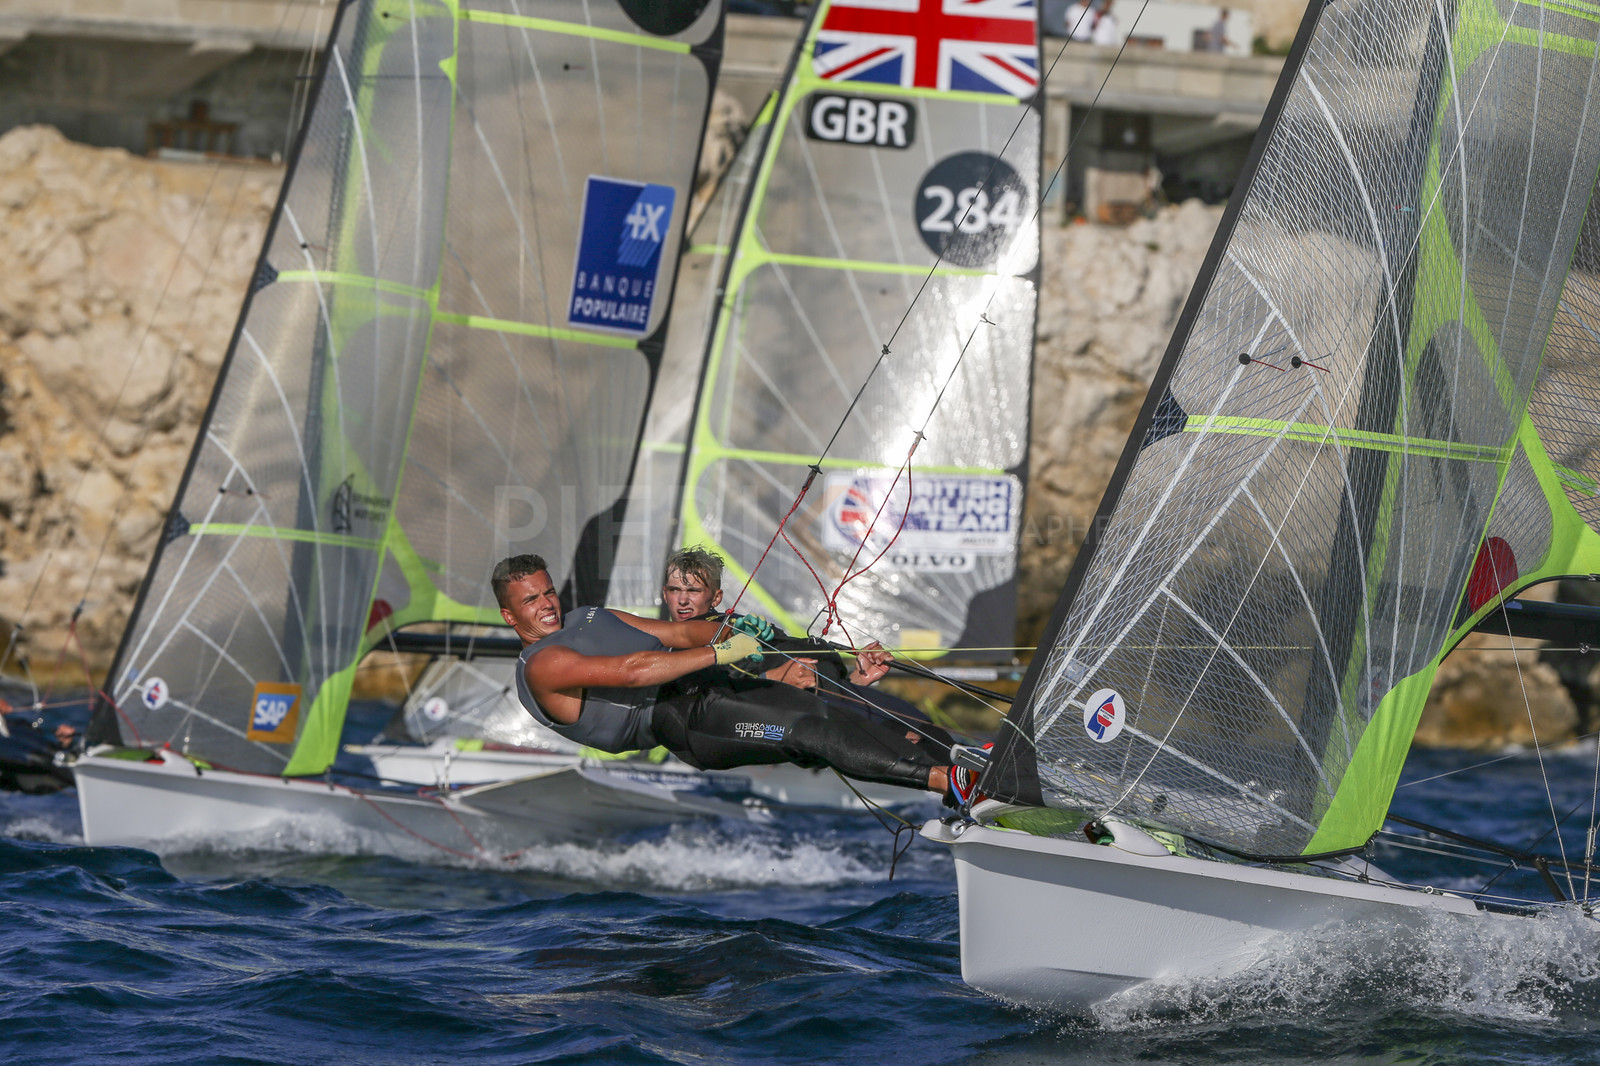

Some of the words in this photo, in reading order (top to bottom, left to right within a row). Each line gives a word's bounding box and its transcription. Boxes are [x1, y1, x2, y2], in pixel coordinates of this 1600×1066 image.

[811, 96, 908, 147] GBR
[920, 185, 1024, 235] 284
[577, 271, 653, 298] BANQUE
[573, 296, 649, 325] POPULAIRE
[897, 480, 1008, 497] RITISH
[926, 513, 1007, 530] TEAM
[885, 551, 967, 568] OLVO
[254, 699, 288, 726] SAP
[735, 730, 765, 738] GUL
